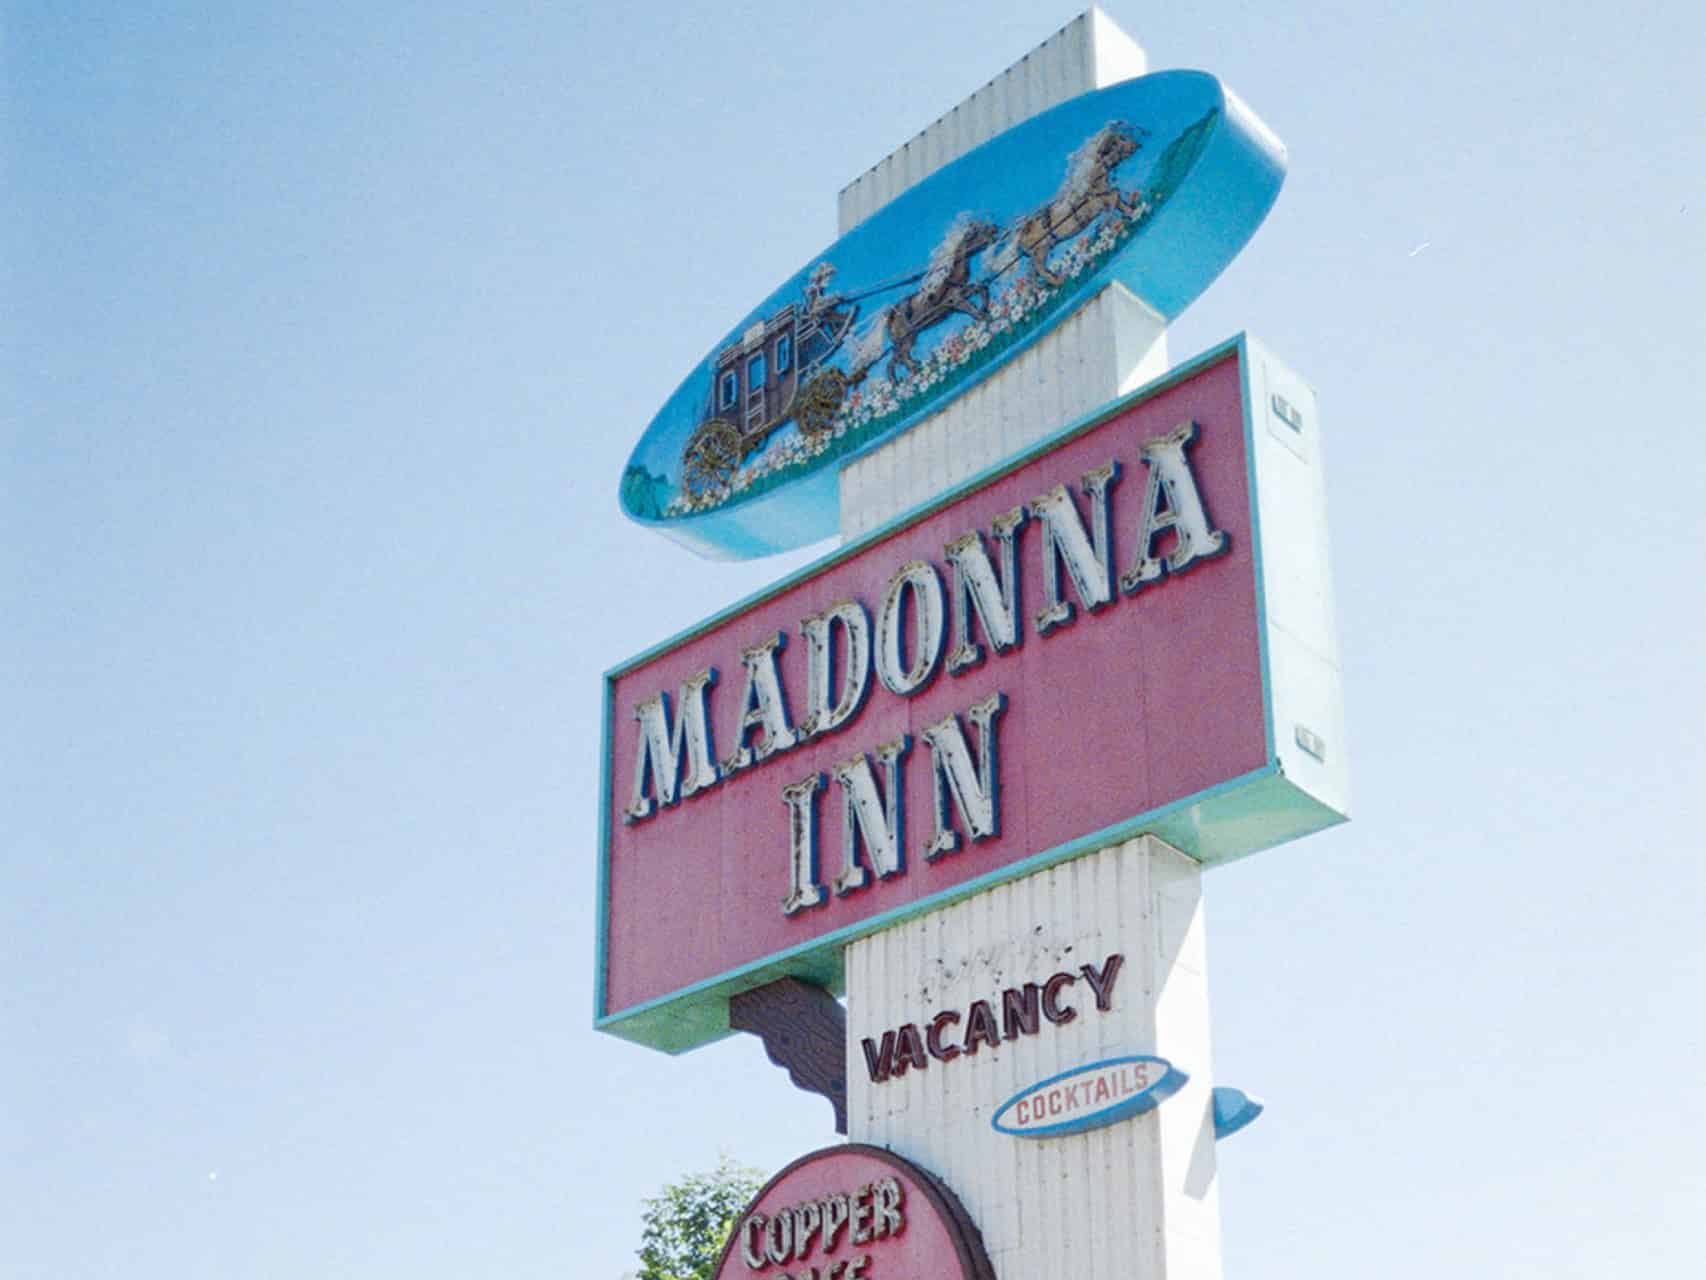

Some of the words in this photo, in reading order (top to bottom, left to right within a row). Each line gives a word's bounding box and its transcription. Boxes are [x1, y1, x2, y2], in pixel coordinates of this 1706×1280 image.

[625, 422, 1229, 826] MADONNA
[783, 692, 1008, 917] INN
[861, 953, 1125, 1084] VACANCY
[1016, 1063, 1148, 1126] COCKTAILS
[742, 1176, 904, 1270] COPPER
